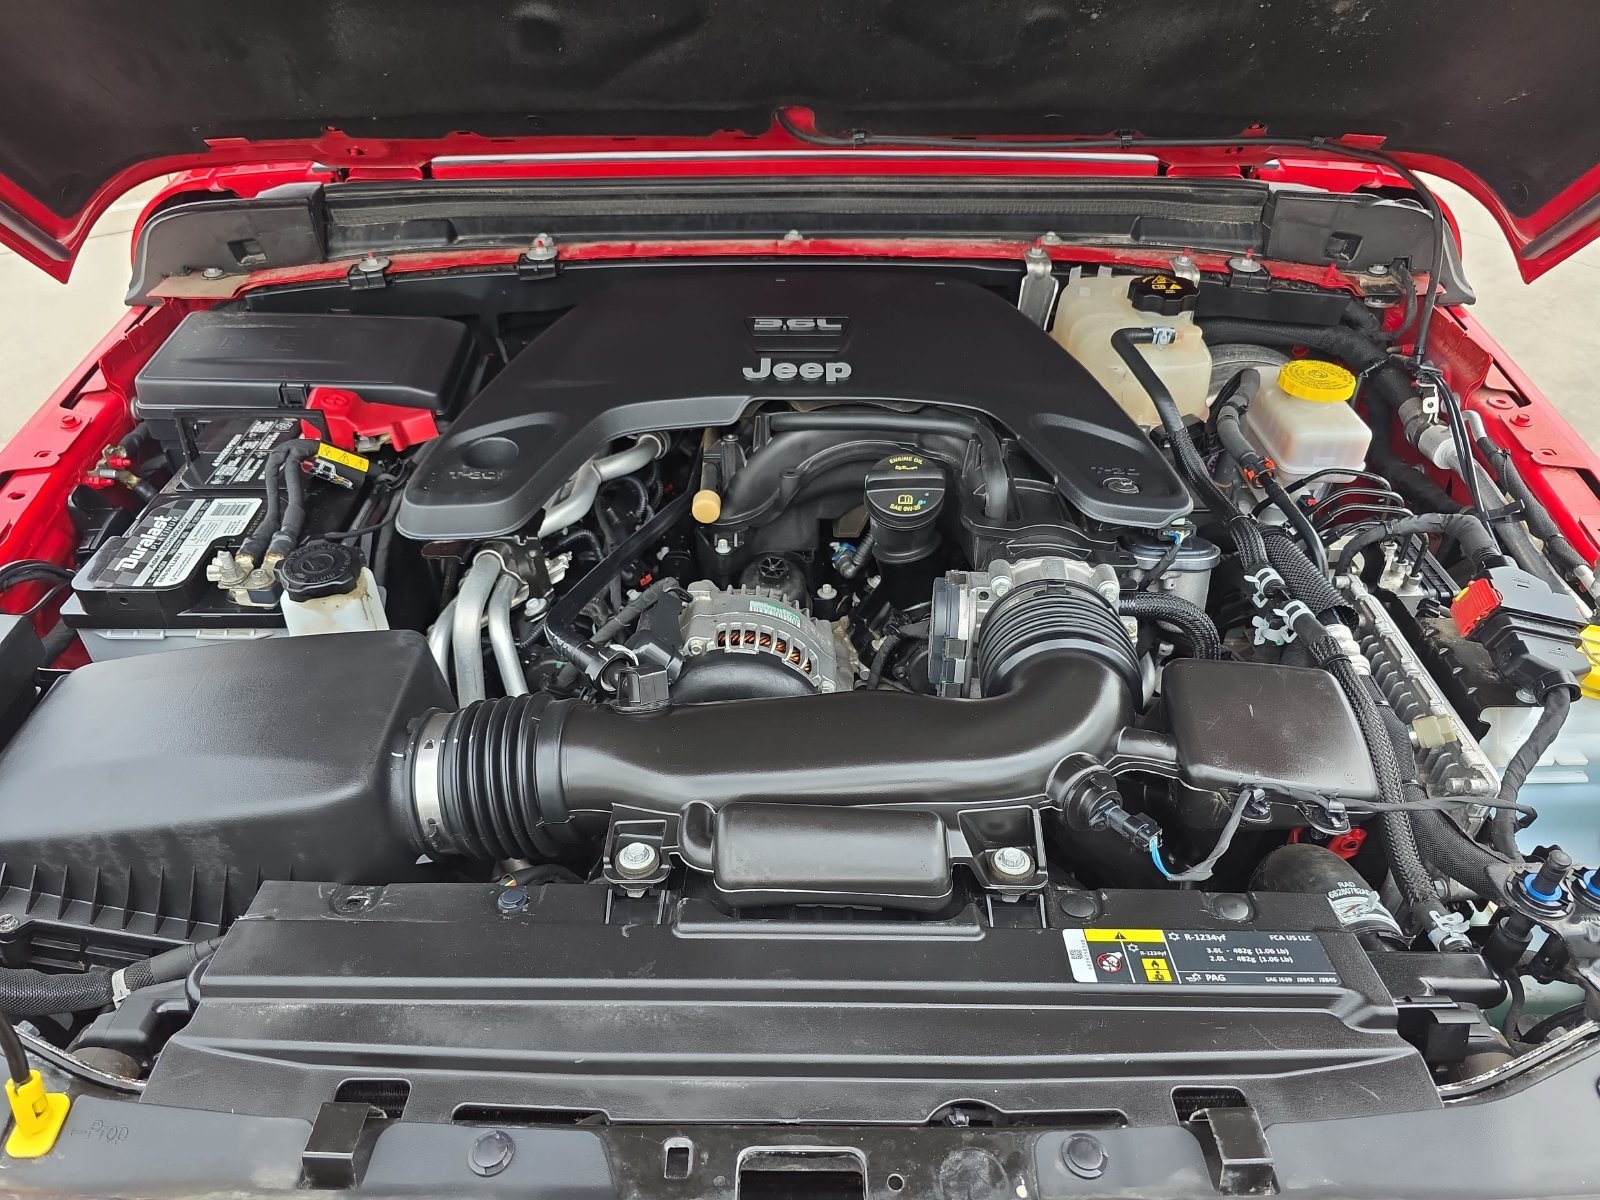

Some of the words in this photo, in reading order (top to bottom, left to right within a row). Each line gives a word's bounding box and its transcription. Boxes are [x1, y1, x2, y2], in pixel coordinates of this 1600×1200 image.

[753, 318, 842, 331] 3.6L
[742, 357, 852, 384] Jeep
[888, 456, 913, 464] ENGINE
[913, 457, 923, 465] OIL
[889, 503, 902, 512] SAE
[151, 515, 182, 550] PLATINUM
[114, 515, 173, 571] Duralast
[149, 554, 161, 569] AGM
[160, 518, 188, 553] TECHNOLOGY
[1183, 933, 1227, 942] R-1234yf
[1232, 947, 1253, 955] 482g
[1255, 947, 1275, 955] (1.06
[1276, 948, 1290, 956] Lb)
[1280, 956, 1294, 964] Lb)
[1204, 974, 1227, 982] PAG
[87, 1119, 129, 1147] Prop
